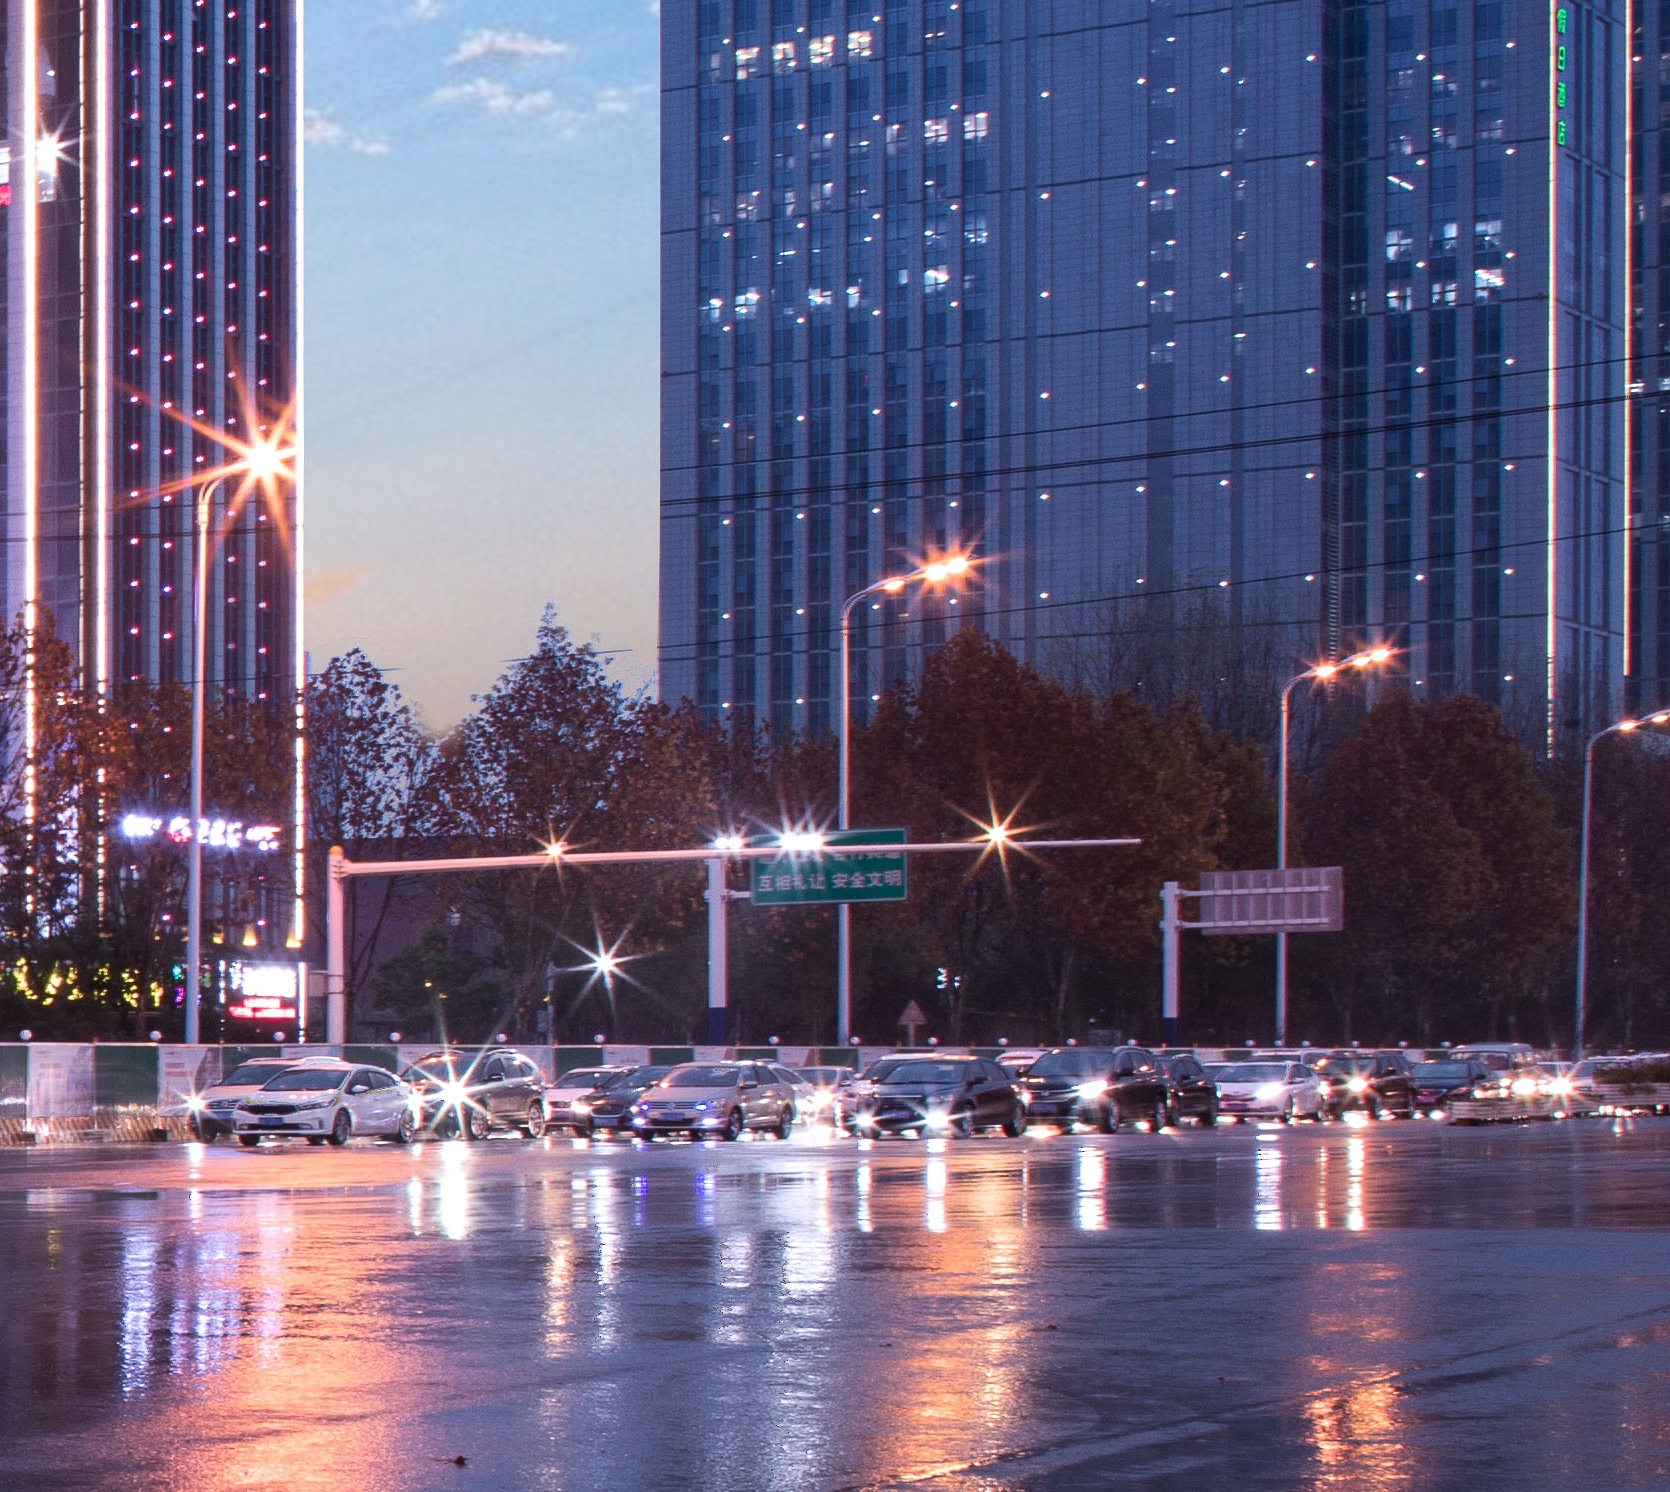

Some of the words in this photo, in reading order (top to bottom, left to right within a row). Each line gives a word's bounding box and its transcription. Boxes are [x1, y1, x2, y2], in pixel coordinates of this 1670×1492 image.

[758, 873, 825, 892] 互相礼让
[831, 870, 903, 888] 安全文明
